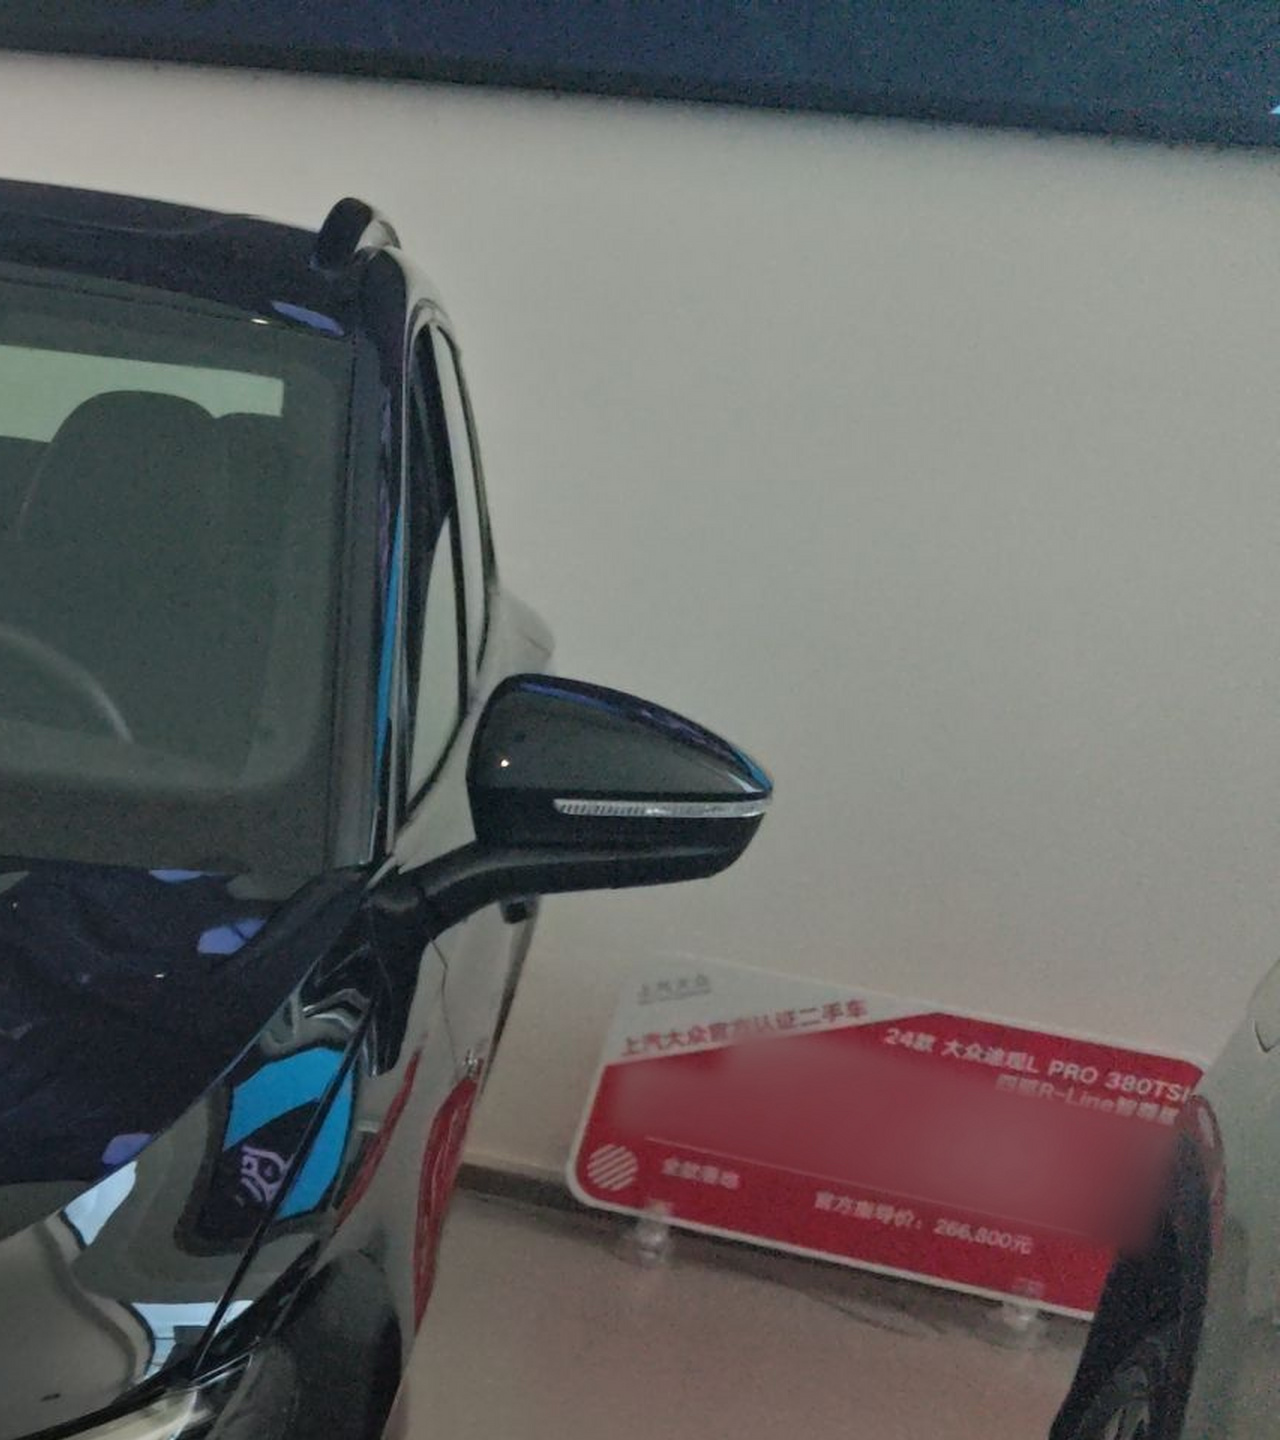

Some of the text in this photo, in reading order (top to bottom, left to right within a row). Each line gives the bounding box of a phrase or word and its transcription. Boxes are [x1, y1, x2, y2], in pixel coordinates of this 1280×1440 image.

[622, 999, 869, 1056] 上汽大众官方认证二手车
[1047, 1060, 1099, 1085] PRO
